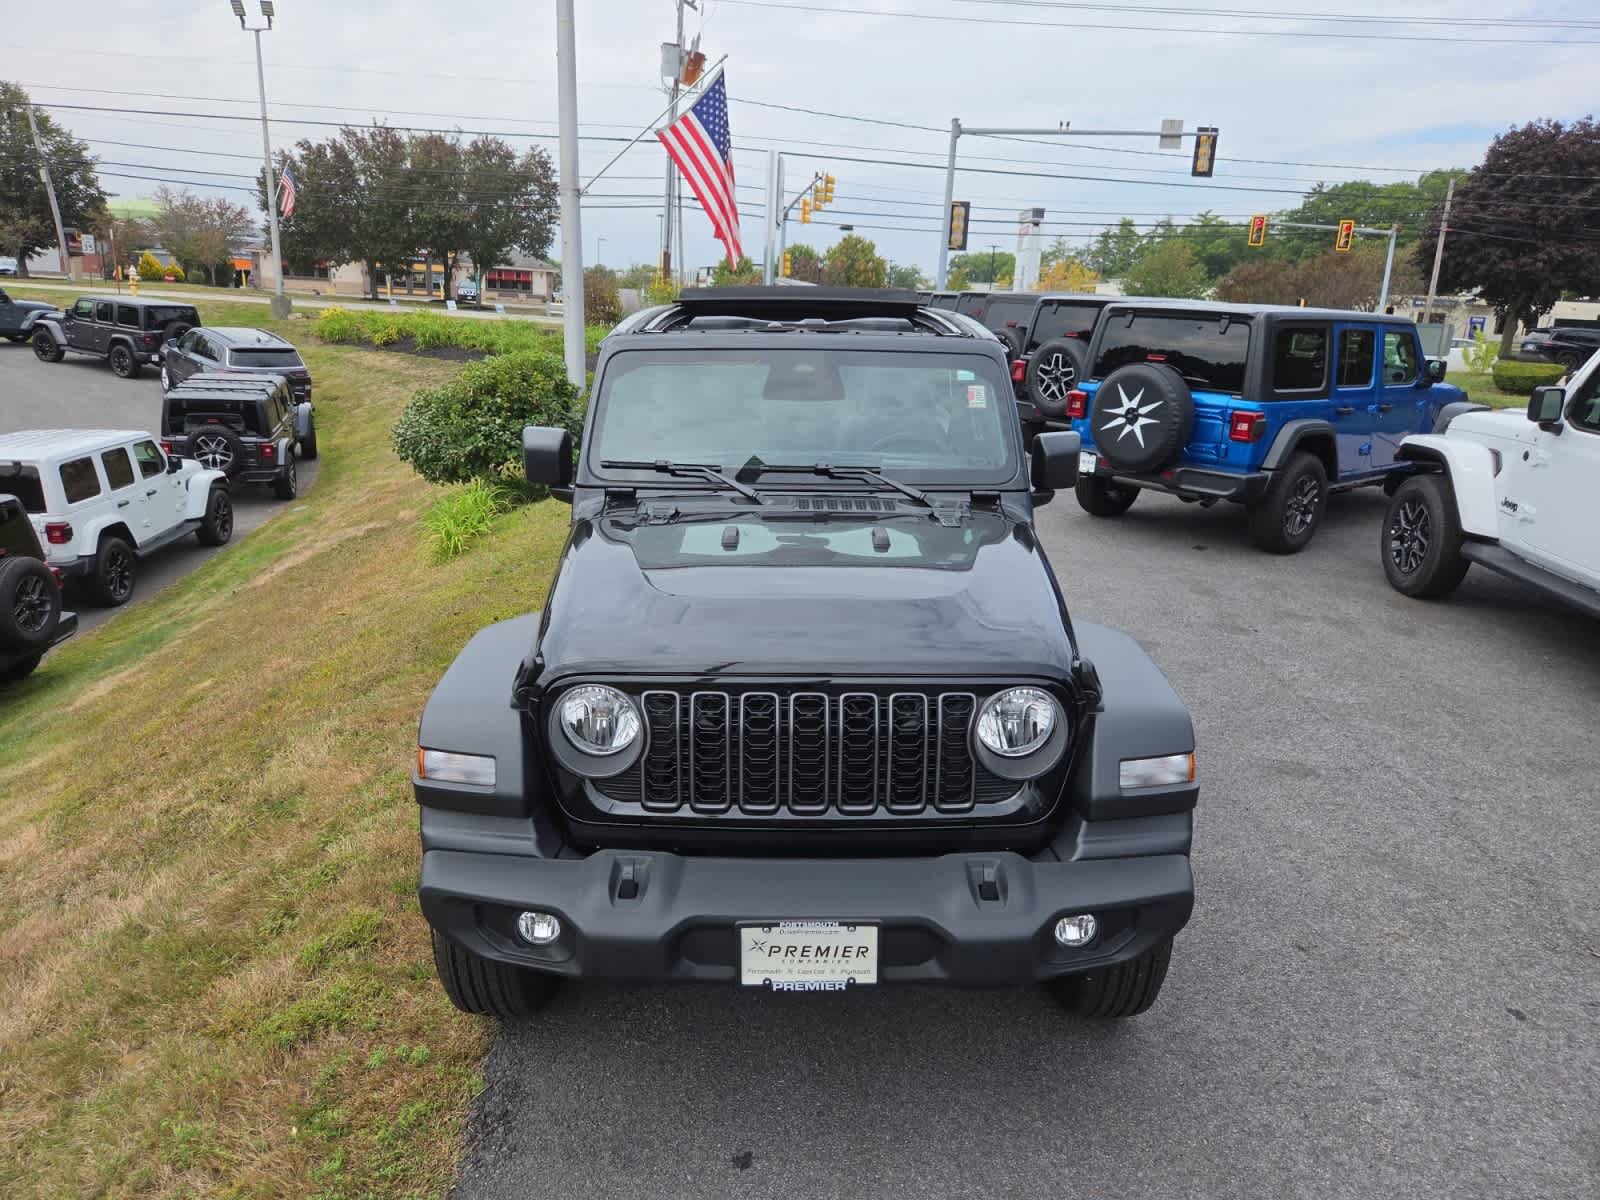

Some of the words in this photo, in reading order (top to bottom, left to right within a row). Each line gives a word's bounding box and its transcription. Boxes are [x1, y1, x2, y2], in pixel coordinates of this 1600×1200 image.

[1501, 496, 1518, 512] Jeep
[768, 945, 869, 958] PREMIER
[772, 981, 847, 991] PREMIER
